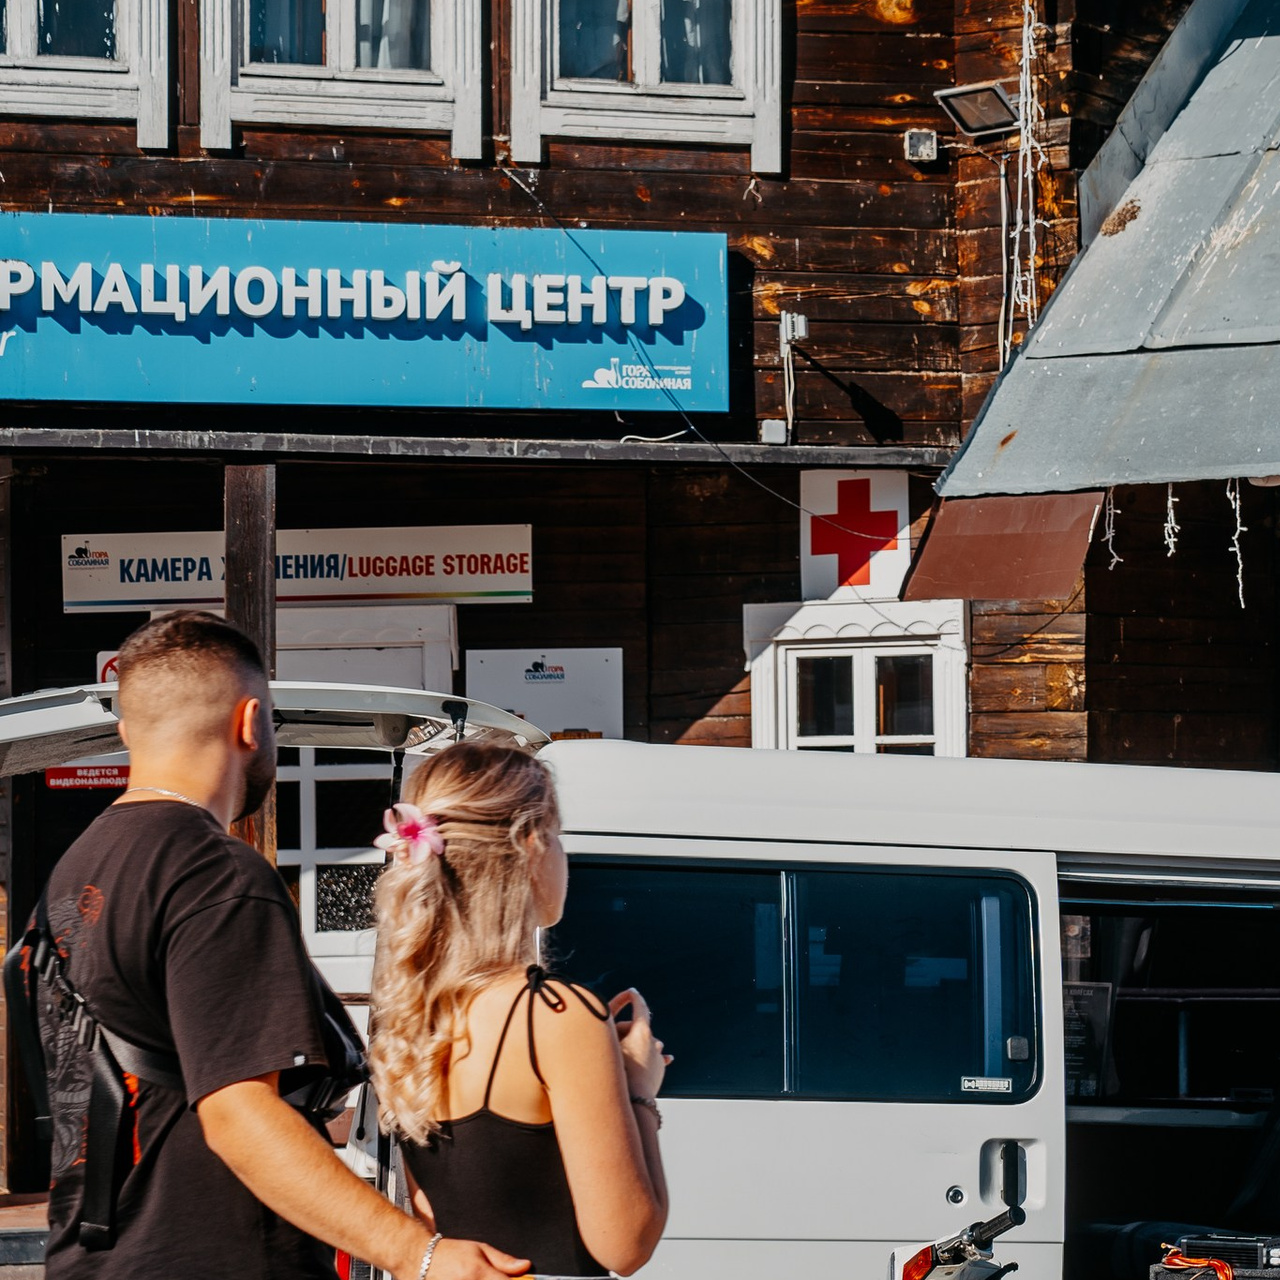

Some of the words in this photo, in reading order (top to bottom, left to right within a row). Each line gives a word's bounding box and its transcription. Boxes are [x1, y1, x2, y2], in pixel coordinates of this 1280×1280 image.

[0, 260, 466, 322] РМАЦИОННЫЙ
[488, 273, 686, 331] ЦЕНТР
[68, 558, 109, 566] СОБОЛИНАЯ
[119, 557, 213, 583] КАМЕРА
[442, 553, 529, 575] STORAGE
[77, 768, 119, 776] ВЕДЕТСЯ
